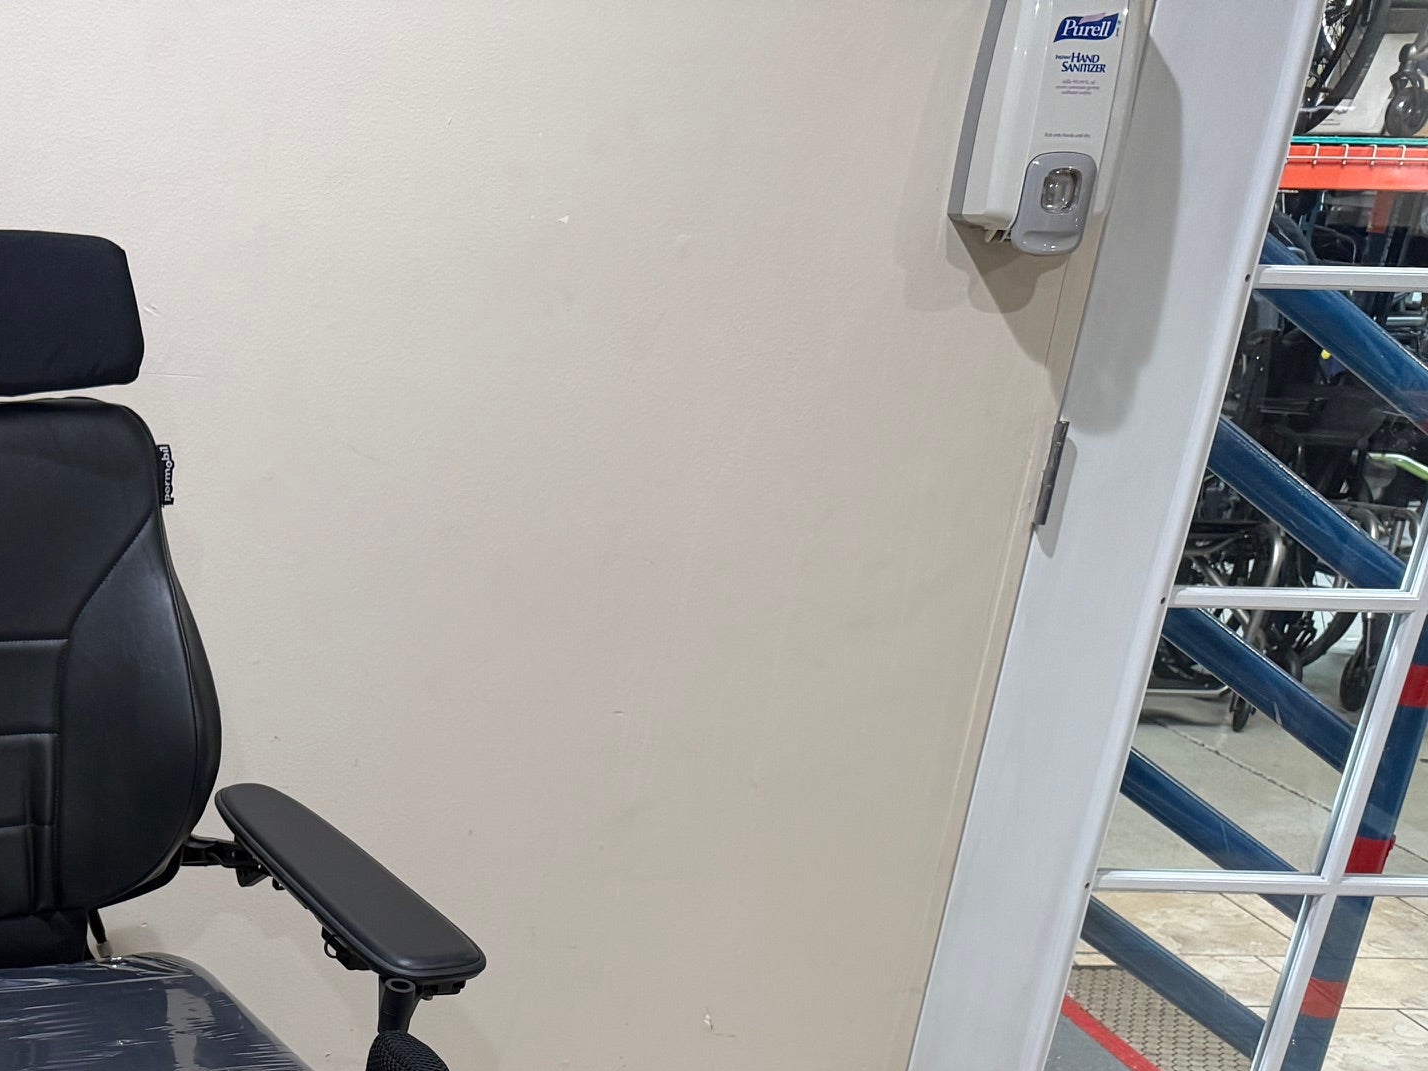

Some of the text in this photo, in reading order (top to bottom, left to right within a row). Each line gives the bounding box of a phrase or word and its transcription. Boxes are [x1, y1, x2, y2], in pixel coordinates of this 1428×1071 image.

[1061, 19, 1112, 37] Purell
[1071, 52, 1100, 64] HAND
[1061, 61, 1106, 73] SANITIZER
[159, 446, 173, 502] permobil
